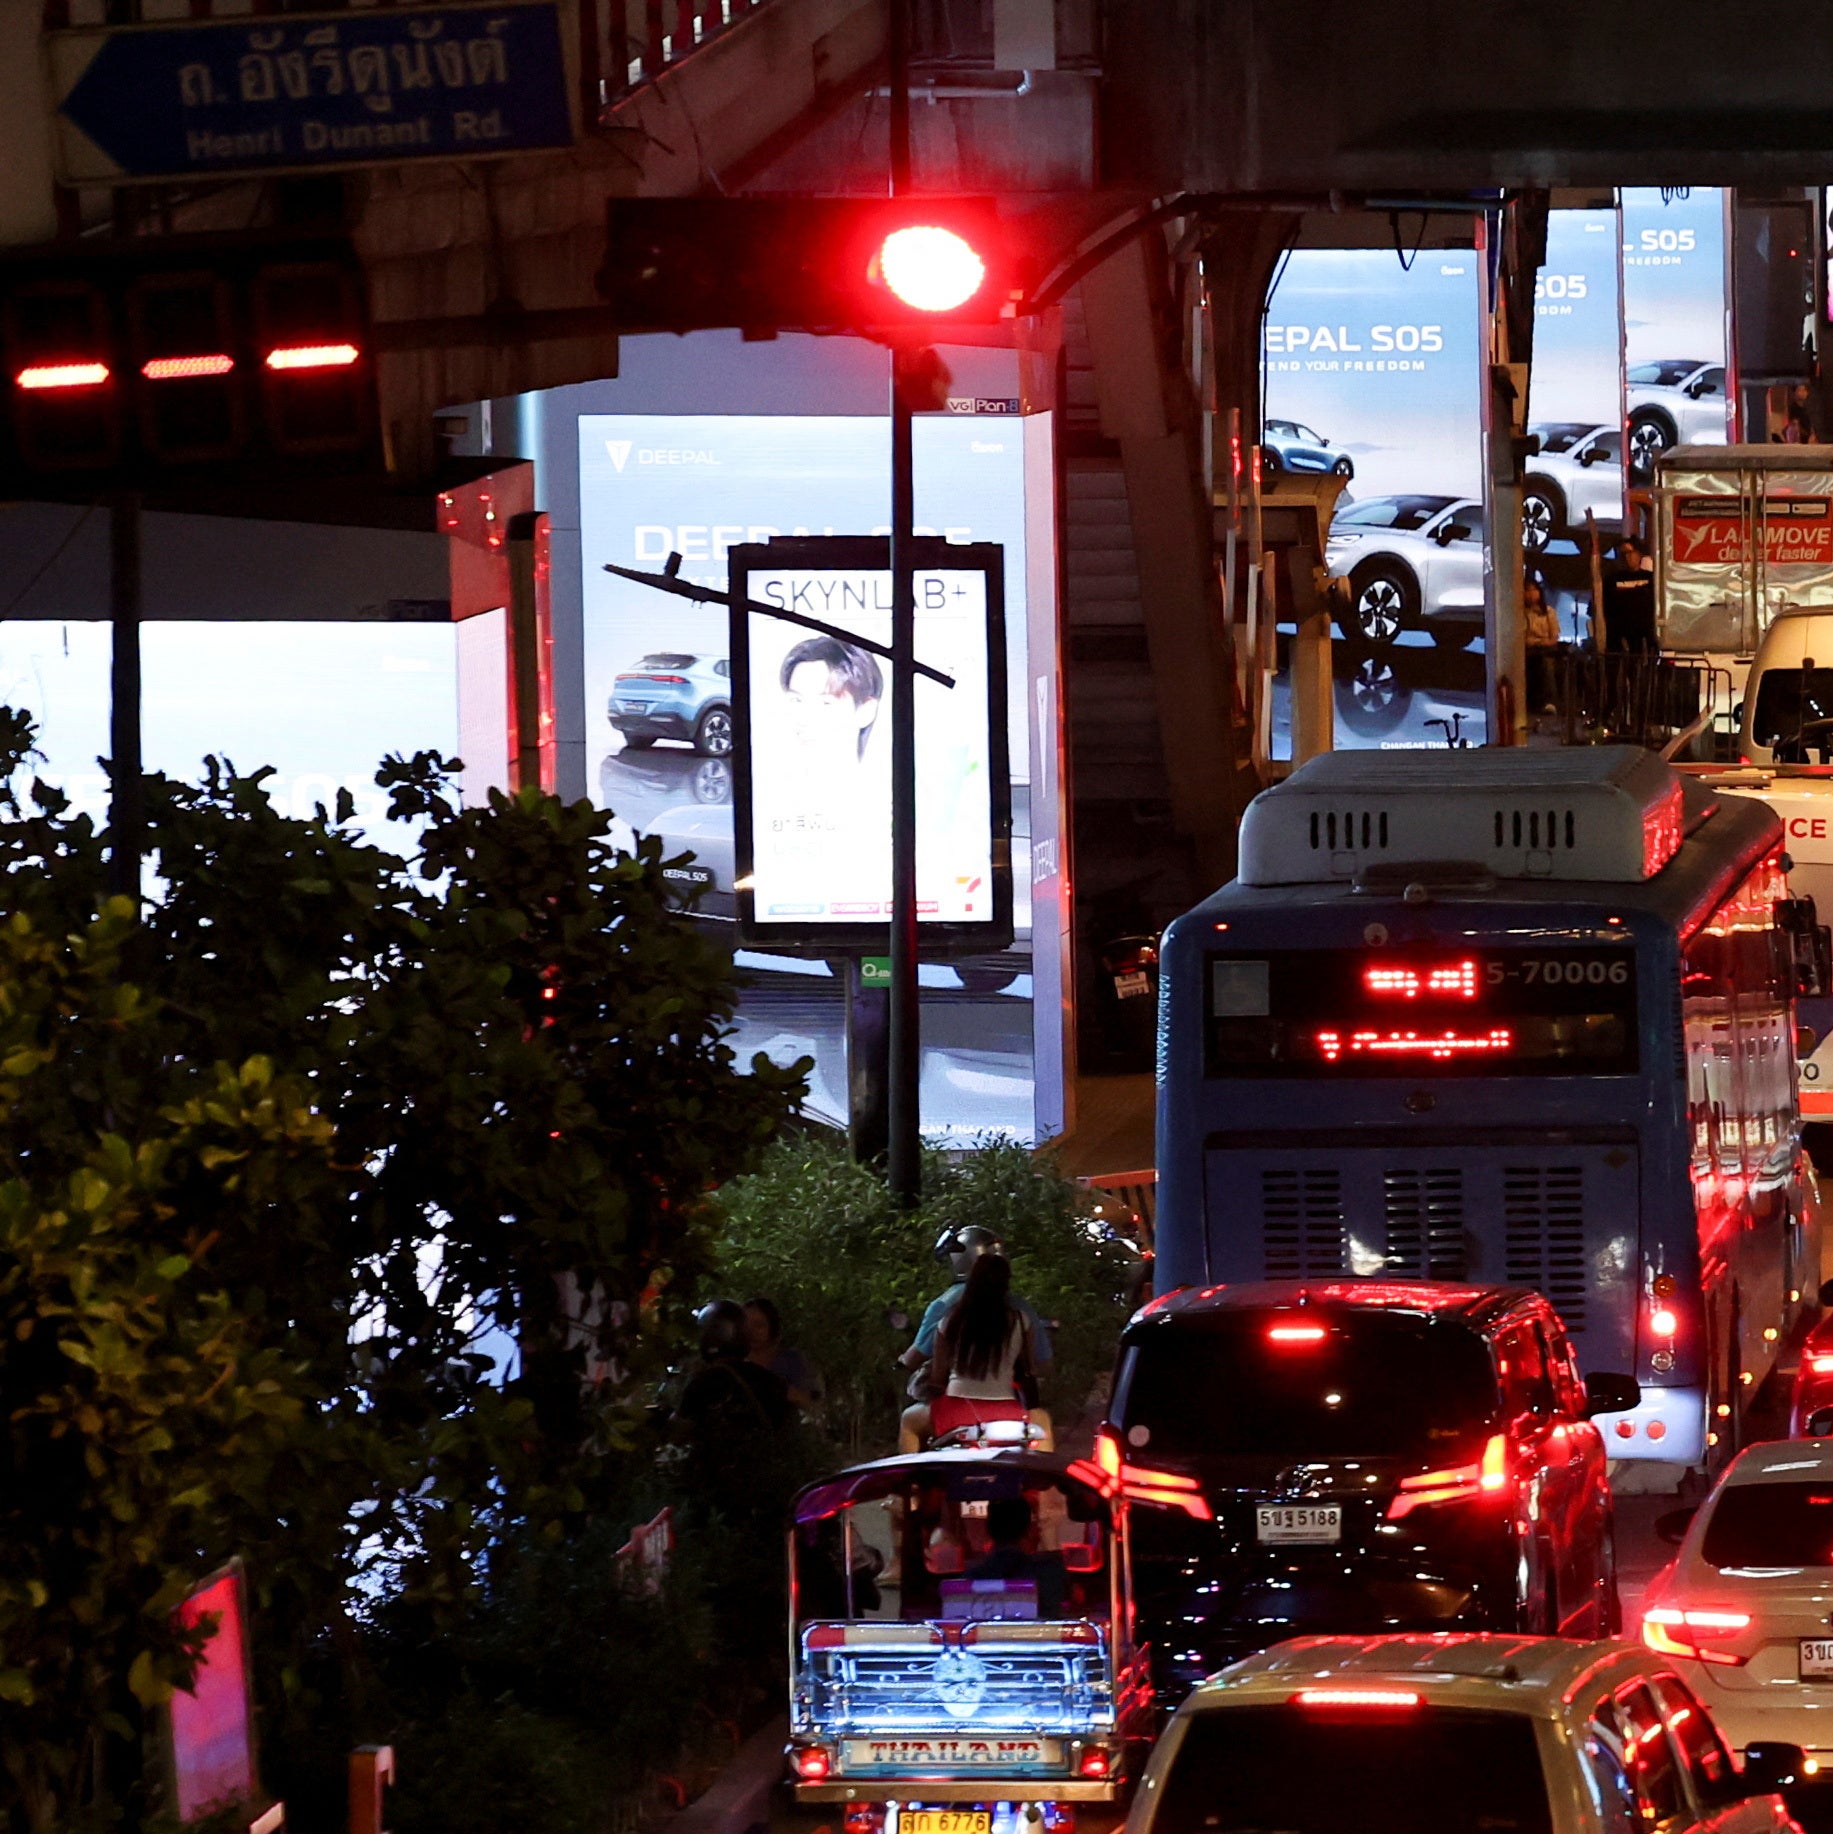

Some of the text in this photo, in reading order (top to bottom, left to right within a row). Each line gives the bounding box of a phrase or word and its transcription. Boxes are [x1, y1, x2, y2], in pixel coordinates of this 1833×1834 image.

[238, 17, 509, 113] อังรีดูนังต์
[185, 124, 284, 161] Henri
[302, 116, 432, 151] Dunant
[1640, 229, 1697, 252] S05
[1371, 325, 1444, 352] S05
[1305, 360, 1339, 372] YOUR
[1344, 360, 1426, 372] FREEDOM
[638, 449, 722, 465] DEEPAL
[1298, 1511, 1337, 1526] 5188
[870, 1742, 1040, 1762] THAILAND
[939, 1813, 986, 1831] 6776
